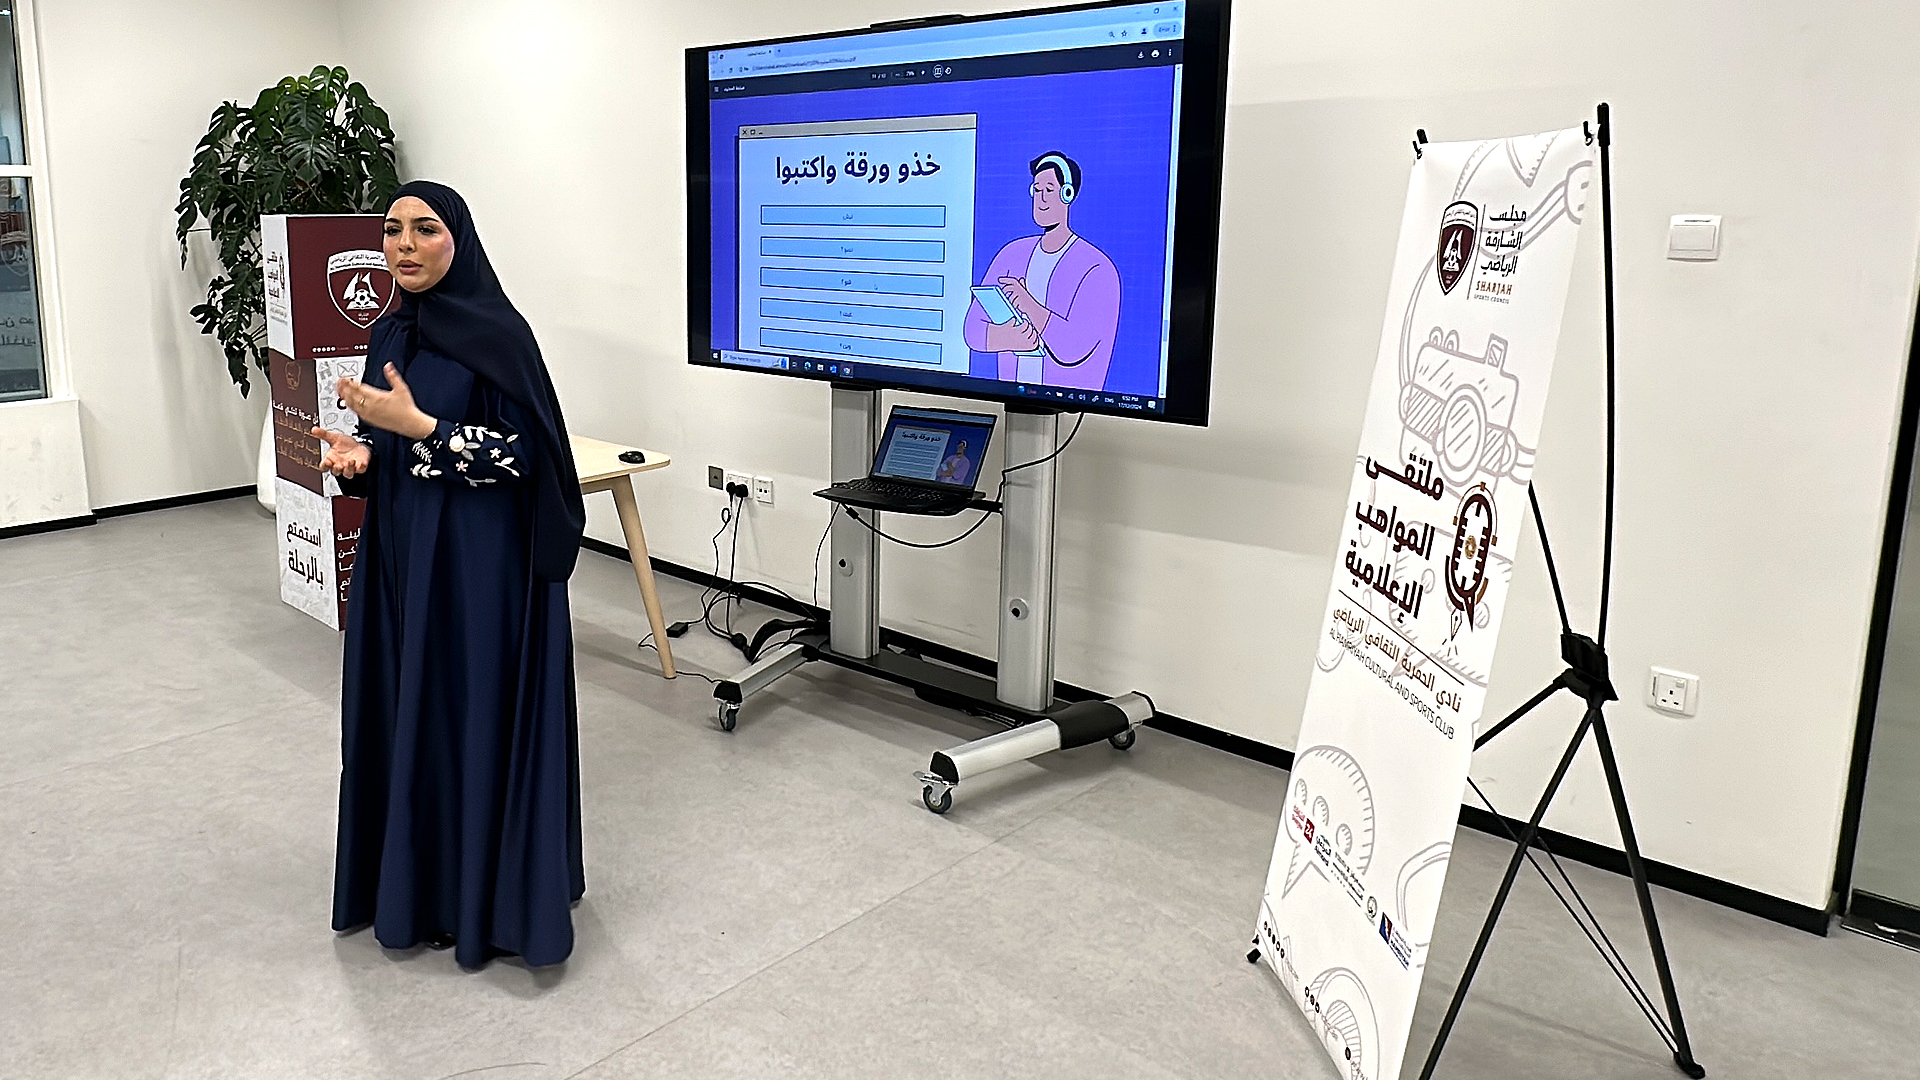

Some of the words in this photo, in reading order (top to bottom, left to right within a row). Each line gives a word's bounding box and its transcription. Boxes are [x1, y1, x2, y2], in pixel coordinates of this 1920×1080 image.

[776, 155, 837, 185] واكتبوا
[844, 151, 890, 184] ورقة
[898, 152, 941, 184] خذو
[1489, 204, 1527, 226] مجلس
[1485, 230, 1523, 252] الشارقة
[1480, 255, 1518, 278] الرياضي
[1476, 280, 1513, 296] SHARJAH
[1366, 452, 1444, 501] ملتقى
[286, 522, 322, 548] استمتع
[1355, 501, 1436, 561] المواهب
[288, 549, 324, 591] بالرحلة
[1345, 539, 1424, 623] الإعلامية
[1333, 607, 1364, 634] الرياضي
[1365, 632, 1400, 662] الثقافي
[1401, 652, 1436, 692] الحمرية
[1364, 656, 1394, 689] CULTURAL
[1394, 682, 1410, 701] AND
[1409, 693, 1435, 724] SPORTS
[1435, 715, 1454, 740] CLUB
[1436, 690, 1462, 713] نادي
